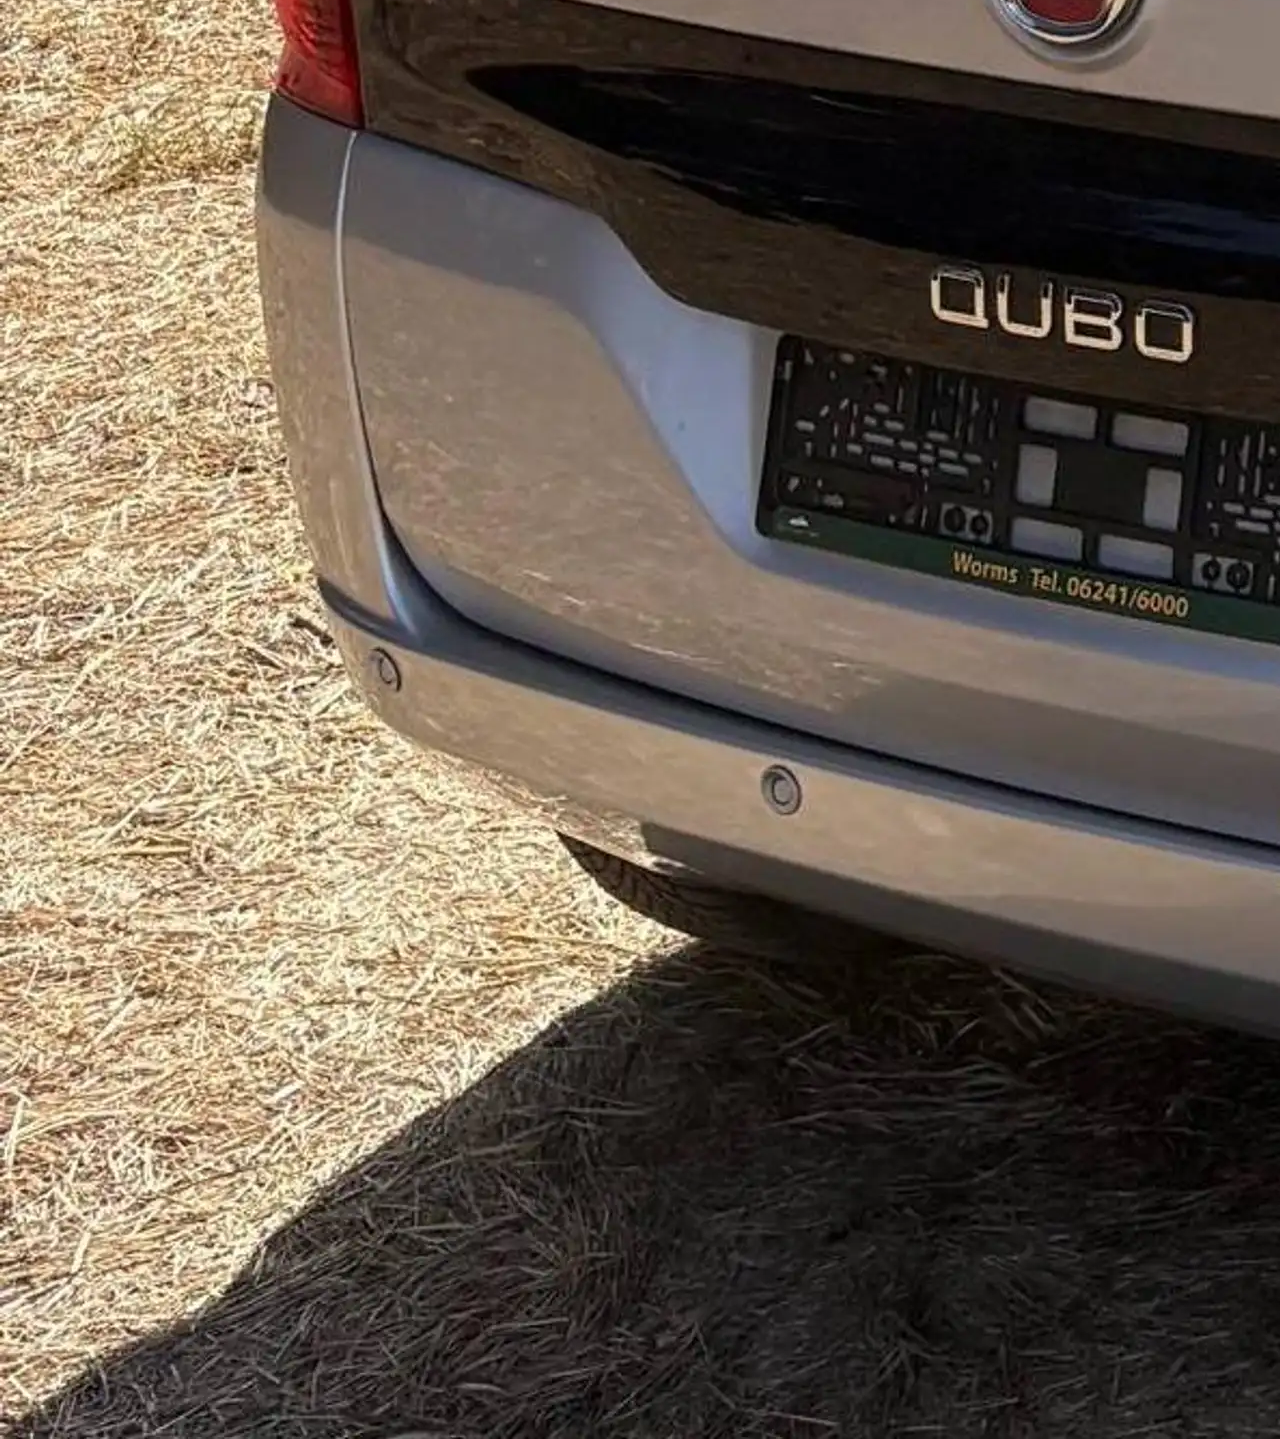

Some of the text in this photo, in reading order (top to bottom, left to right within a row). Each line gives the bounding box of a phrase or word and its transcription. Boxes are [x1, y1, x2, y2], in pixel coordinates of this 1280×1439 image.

[930, 265, 1194, 363] QUBO
[953, 551, 1189, 618] Worms Tel. 06241/6000
